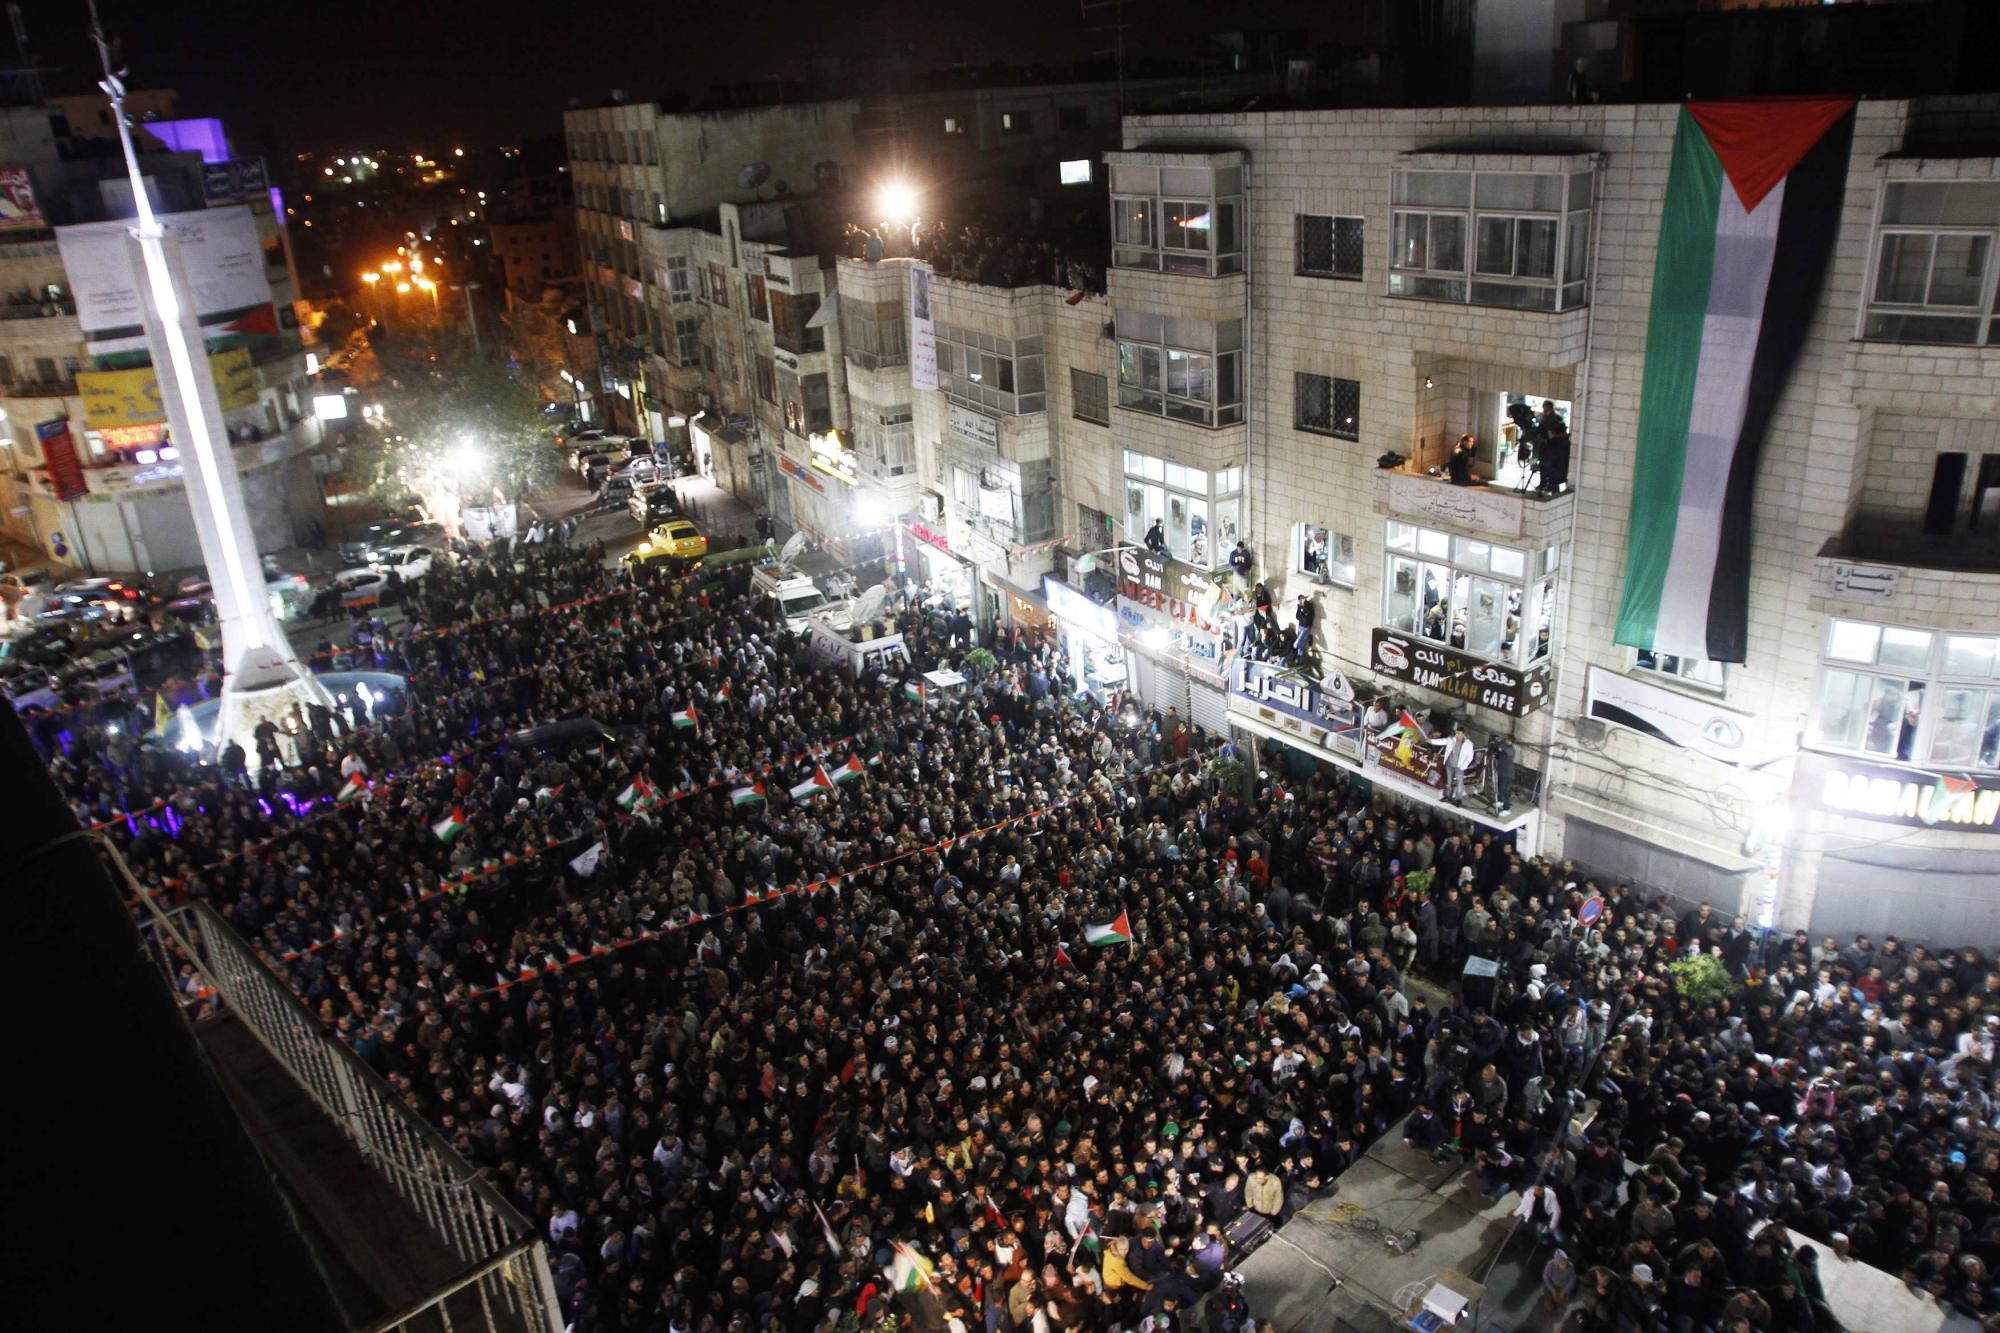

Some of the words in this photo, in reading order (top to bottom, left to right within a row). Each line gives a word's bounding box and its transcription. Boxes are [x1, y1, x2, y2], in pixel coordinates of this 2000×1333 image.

[1144, 558, 1164, 573] الله
[1836, 566, 1893, 580] عمارة
[1834, 580, 1893, 597] رباح
[1415, 649, 1446, 667] الله
[1472, 667, 1517, 687] مقهى
[1413, 666, 1478, 699] RAMALLAH
[1482, 688, 1516, 712] CAFE
